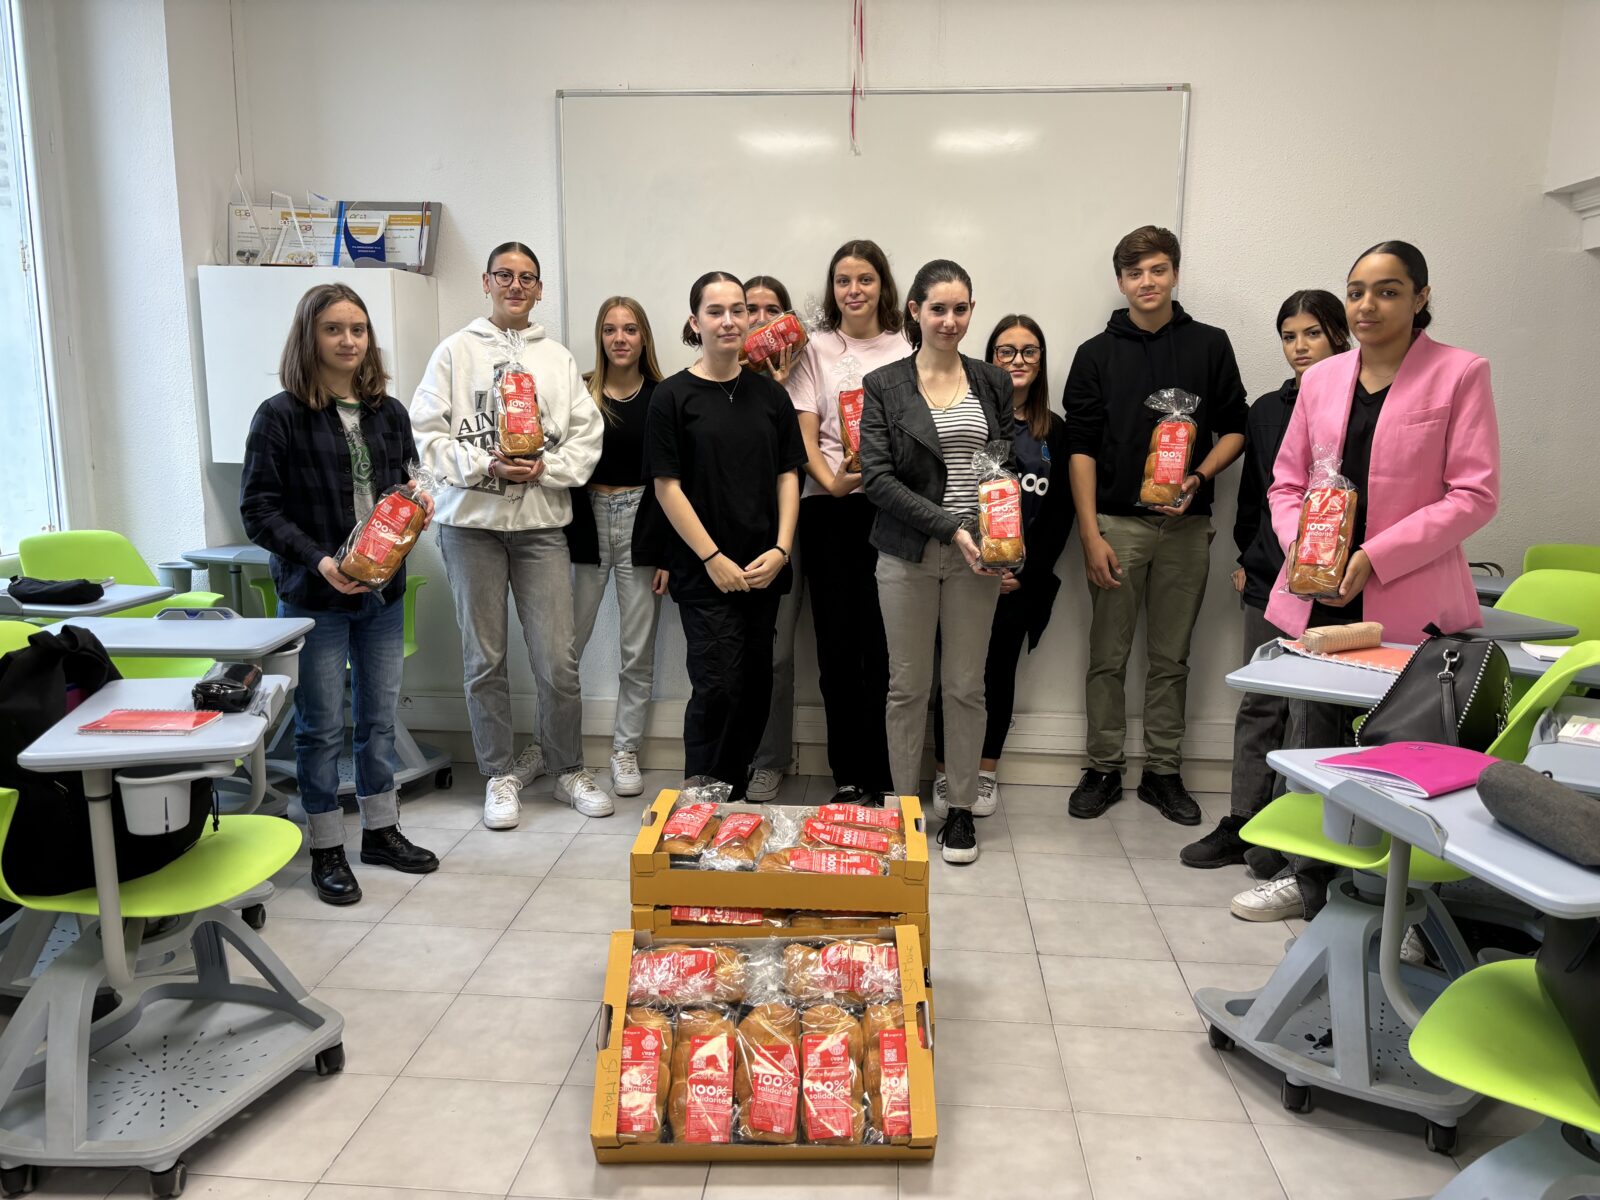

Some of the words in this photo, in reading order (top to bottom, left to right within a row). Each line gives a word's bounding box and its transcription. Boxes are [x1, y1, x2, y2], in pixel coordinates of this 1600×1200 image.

[1158, 450, 1183, 459] 100%
[1306, 522, 1336, 532] 100%
[758, 1072, 793, 1090] 100%
[809, 1080, 845, 1093] 100%
[692, 1083, 728, 1097] 100%
[757, 1085, 792, 1097] solidarité
